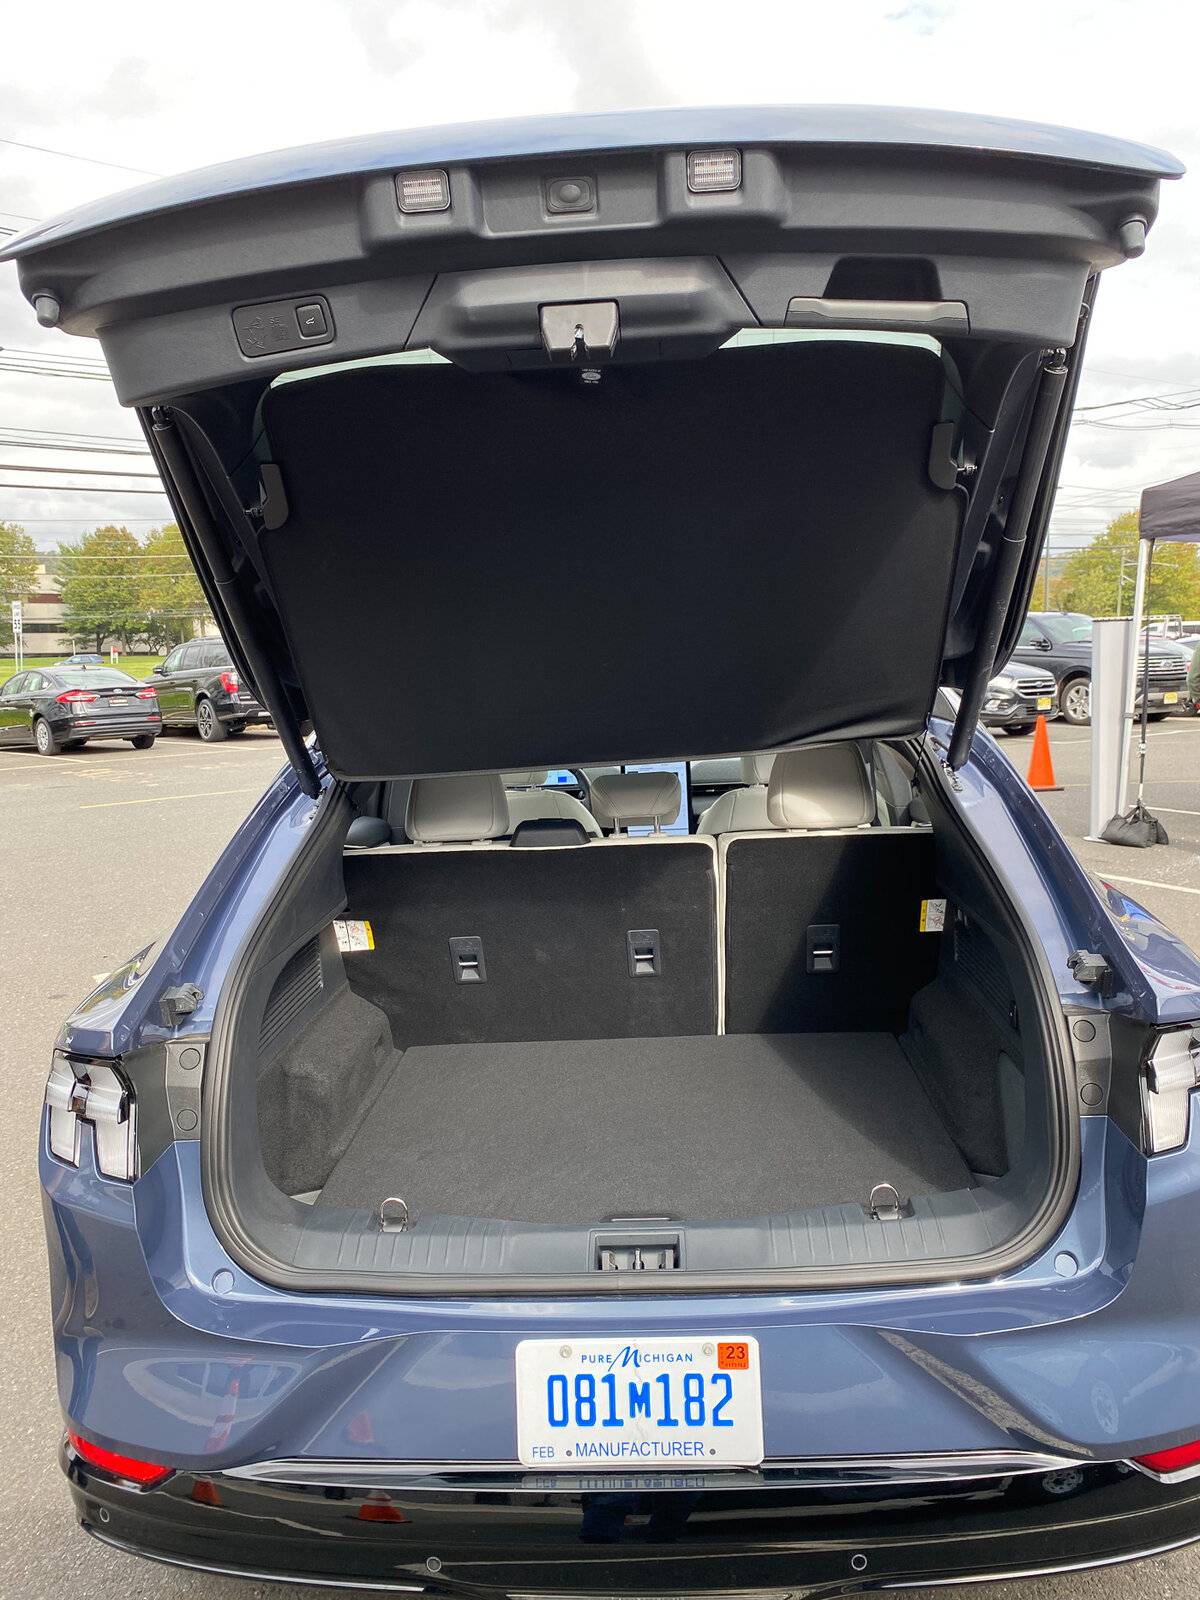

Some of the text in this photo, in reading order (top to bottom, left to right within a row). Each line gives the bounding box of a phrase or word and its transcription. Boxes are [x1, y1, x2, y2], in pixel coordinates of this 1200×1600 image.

[581, 1345, 693, 1372] PURE MICHIGAN
[726, 1345, 746, 1360] 23
[547, 1373, 734, 1427] 081M182
[532, 1446, 555, 1458] FEB
[575, 1441, 705, 1458] MANUFACTURER
